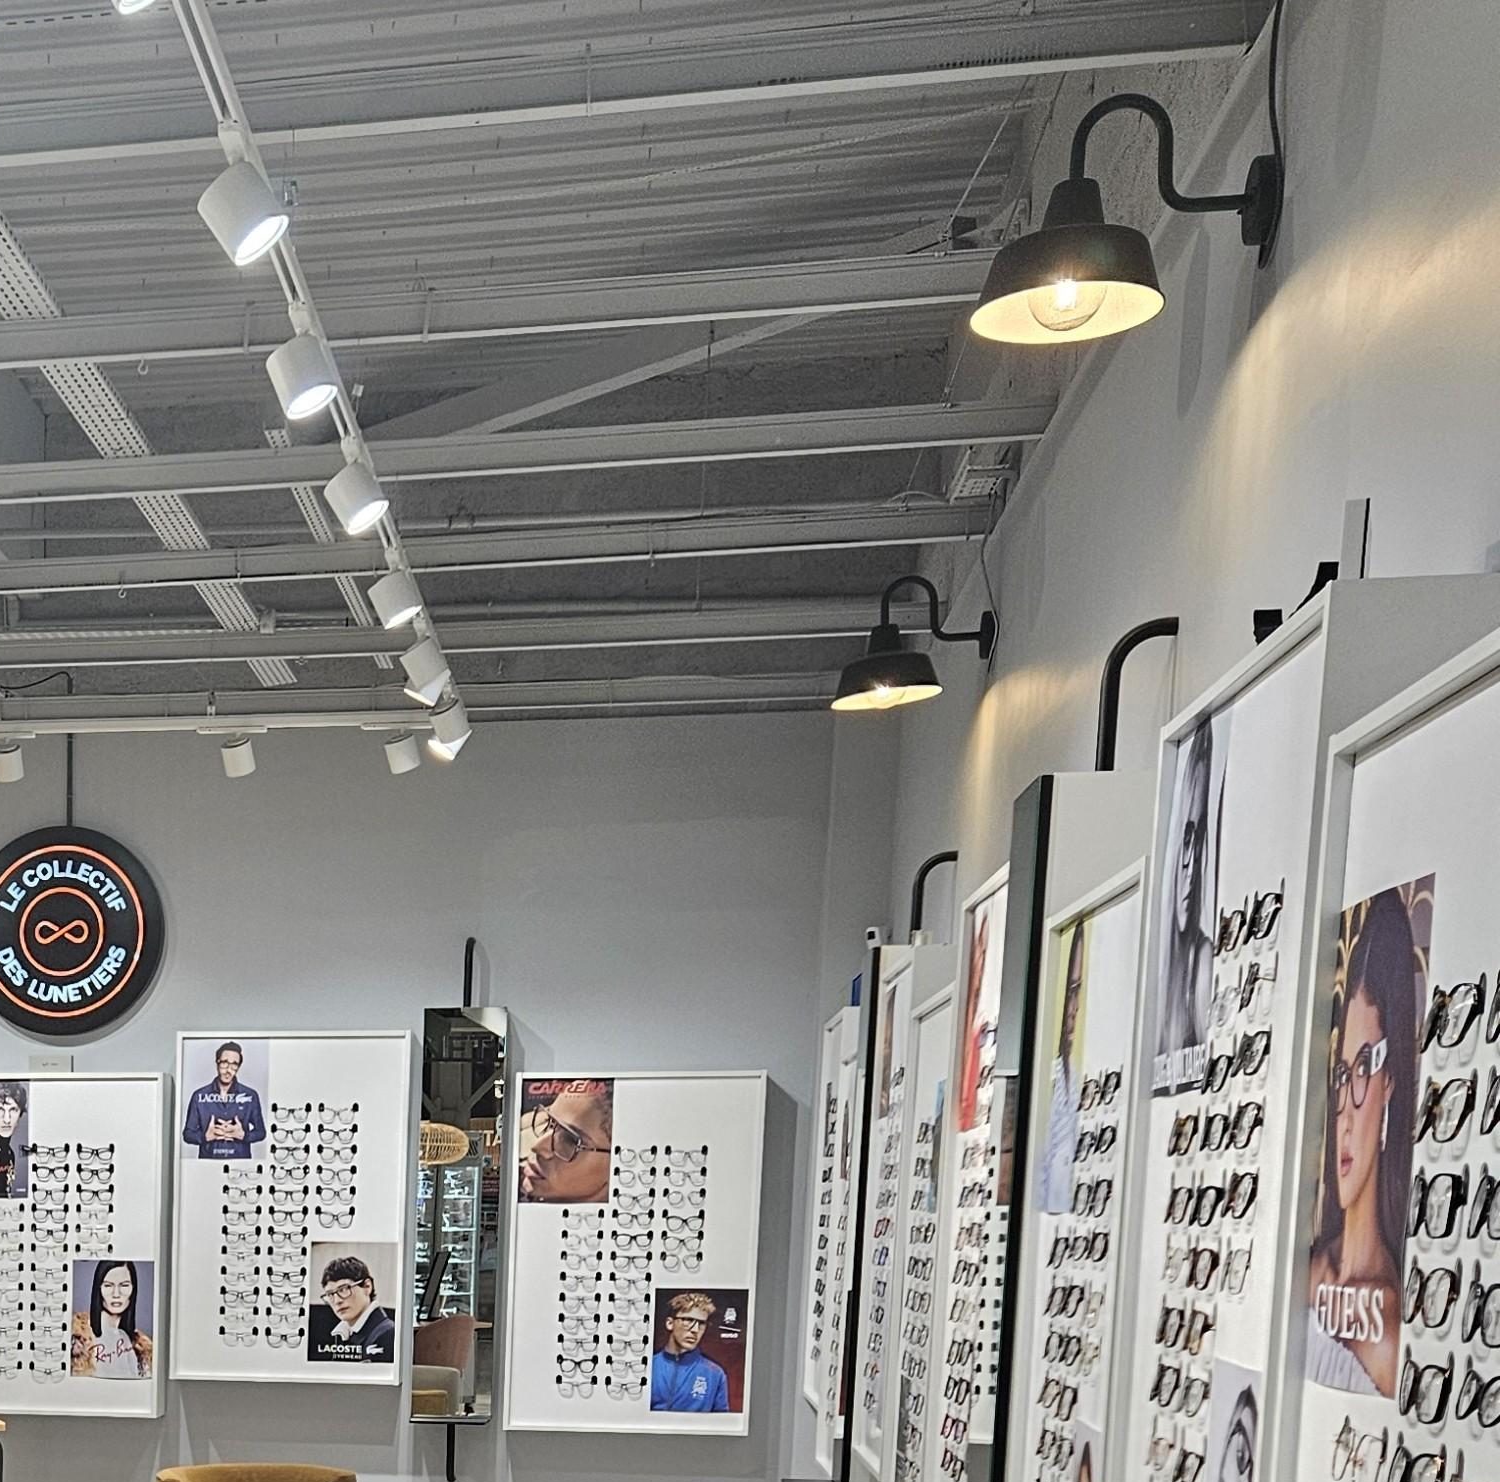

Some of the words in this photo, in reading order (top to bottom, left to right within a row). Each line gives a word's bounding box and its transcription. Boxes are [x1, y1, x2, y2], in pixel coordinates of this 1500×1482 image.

[0, 882, 26, 912] LE
[22, 860, 127, 911] COLLECTIF
[27, 945, 127, 1003] LUNETIERS
[198, 1093, 235, 1103] LACOSTE
[528, 1080, 607, 1094] CARRERA
[1316, 1283, 1384, 1344] GUESS
[317, 1344, 362, 1353] LACOSTE
